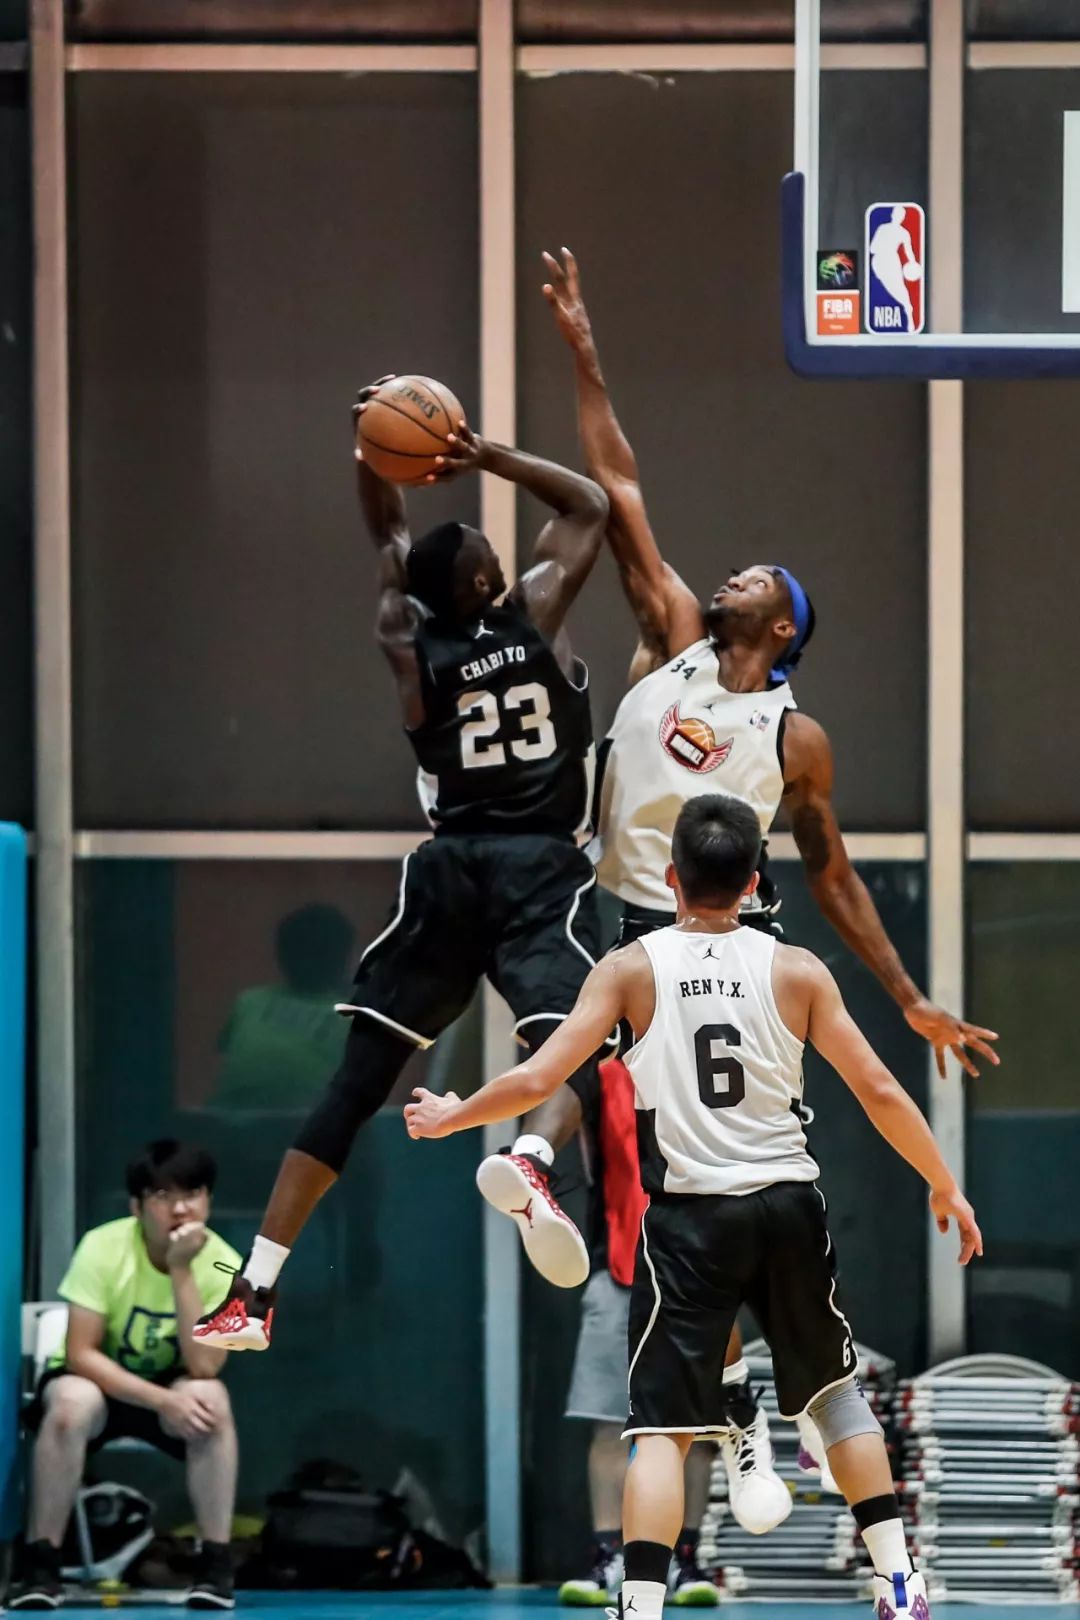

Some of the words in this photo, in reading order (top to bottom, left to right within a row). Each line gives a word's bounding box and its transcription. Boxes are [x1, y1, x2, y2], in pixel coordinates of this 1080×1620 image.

[823, 299, 853, 313] FIBA
[874, 305, 902, 328] NBA
[460, 650, 504, 681] CHABI
[504, 645, 526, 663] YO
[670, 658, 698, 681] 34
[457, 681, 558, 769] 23
[679, 978, 712, 998] REN
[717, 978, 745, 998] Y.X.
[694, 1023, 745, 1109] 6
[842, 1336, 851, 1368] 6
